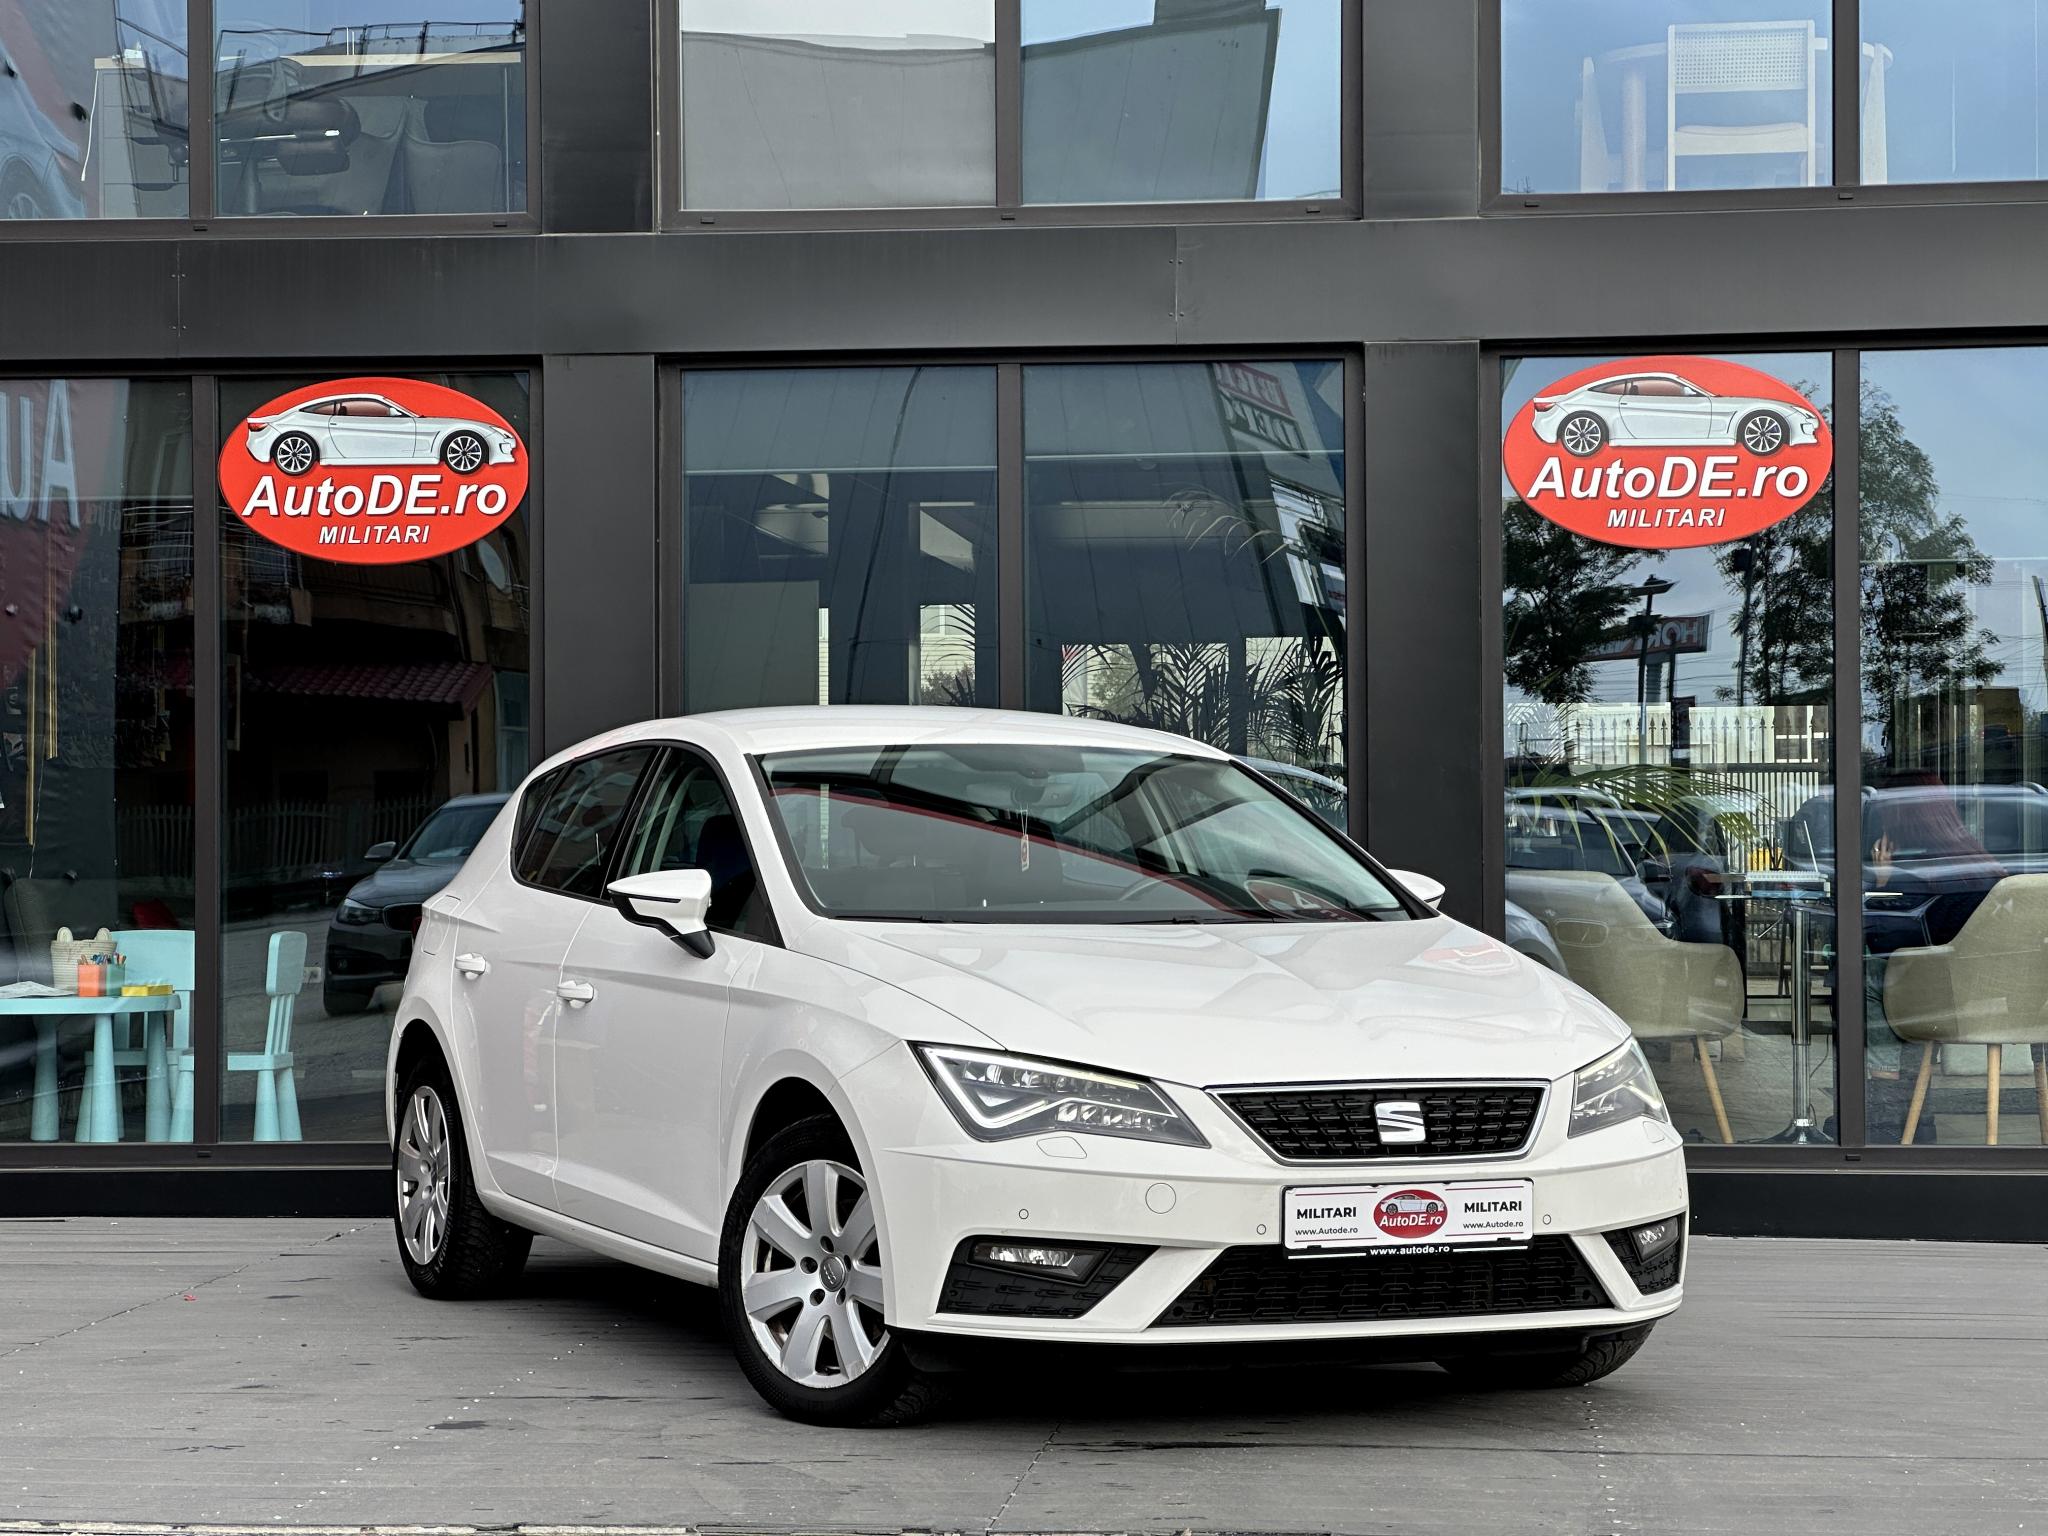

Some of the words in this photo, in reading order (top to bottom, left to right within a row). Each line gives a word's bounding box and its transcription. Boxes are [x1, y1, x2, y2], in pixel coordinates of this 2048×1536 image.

[1527, 455, 1809, 499] AutoDE.ro
[241, 474, 508, 517] AutoDE.ro
[1606, 508, 1727, 528] MILITARI
[318, 525, 431, 544] MILITARI
[1297, 1207, 1356, 1219] MILITARI
[1464, 1201, 1521, 1213] MILITARI
[1379, 1214, 1443, 1227] AutoDE.ro
[1463, 1220, 1523, 1229] www.Autode.ro
[1295, 1227, 1358, 1235] www.Autode.ro
[1370, 1245, 1449, 1255] www.autode.ro
